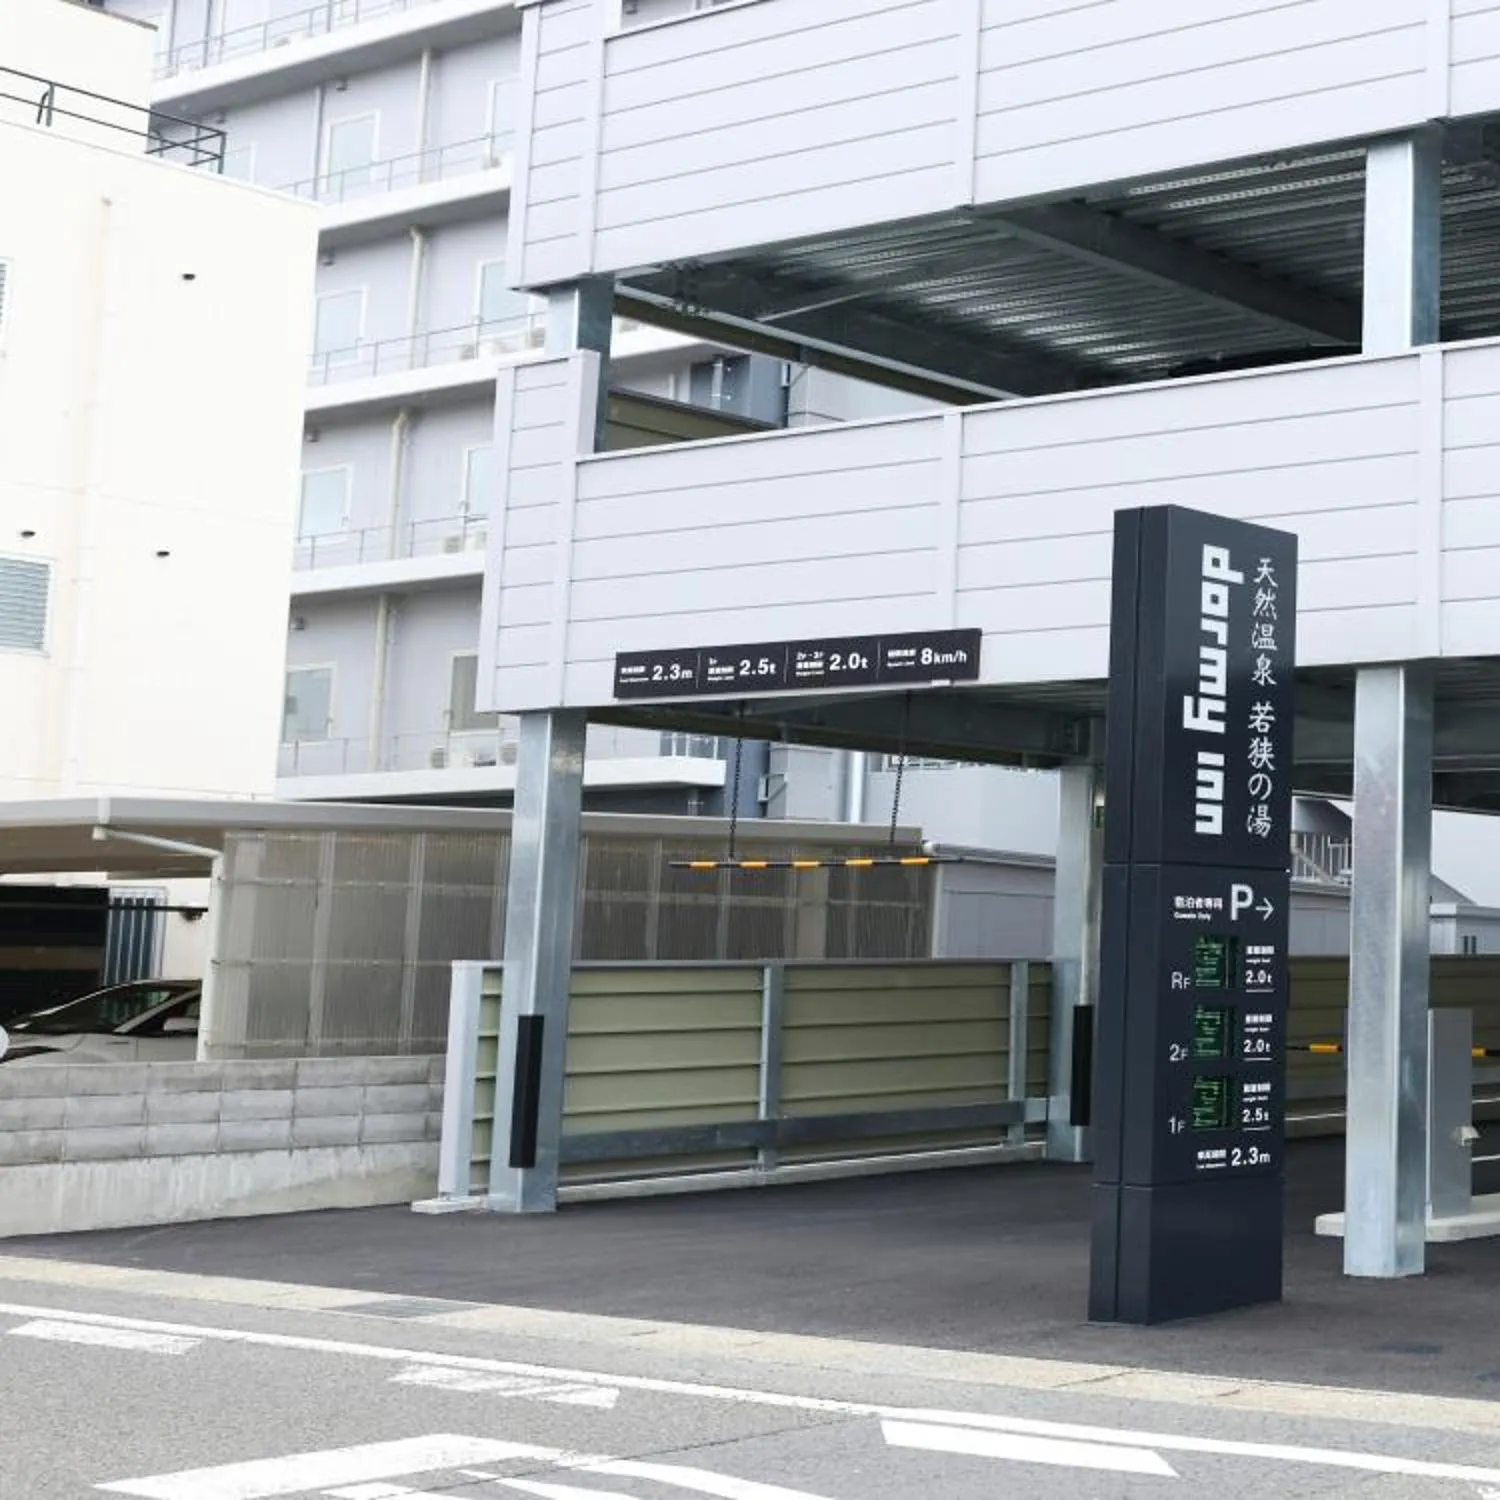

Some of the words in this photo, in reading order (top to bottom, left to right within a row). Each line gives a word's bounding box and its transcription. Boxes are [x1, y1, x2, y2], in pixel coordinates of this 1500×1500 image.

[1251, 557, 1279, 687] 天然温泉
[1183, 543, 1245, 734] dormy
[739, 657, 776, 676] 2.5t
[829, 652, 869, 671] 2.0t
[652, 663, 693, 681] 2.3m
[1246, 701, 1276, 838] 若狭の湯
[1195, 751, 1225, 835] inn
[1231, 883, 1254, 921] P
[1171, 971, 1191, 989] RF
[1245, 969, 1273, 985] 2.0t
[1169, 1044, 1188, 1062] 2F
[1243, 1039, 1271, 1053] 2.0t
[1242, 1107, 1270, 1123] 2.5t
[1168, 1116, 1186, 1134] 1F
[1231, 1146, 1271, 1167] 2.3m
